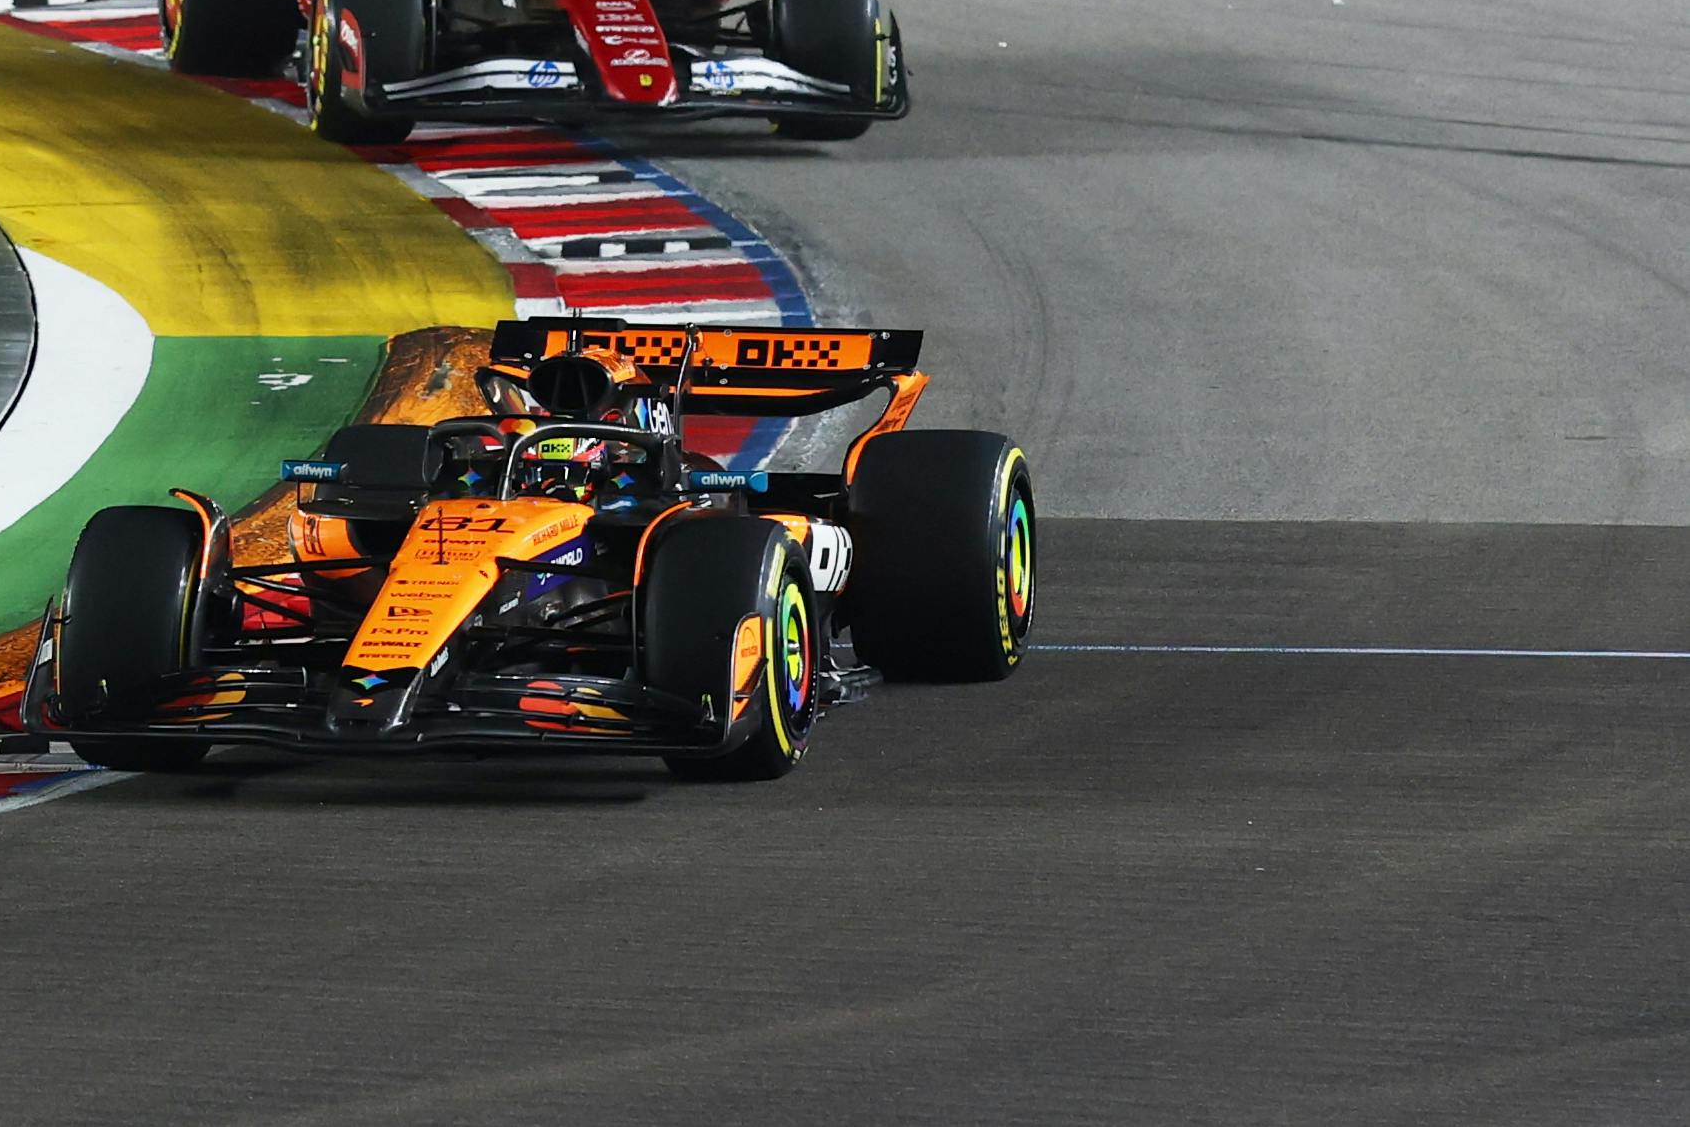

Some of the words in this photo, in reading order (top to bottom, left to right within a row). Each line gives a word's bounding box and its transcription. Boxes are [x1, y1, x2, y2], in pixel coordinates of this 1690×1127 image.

[736, 338, 841, 367] OKX
[541, 443, 571, 453] OKX
[293, 463, 333, 479] allwyn
[701, 473, 746, 488] allwyn
[419, 516, 515, 534] 81
[996, 567, 1013, 655] ZERO
[370, 627, 428, 635] FxPro
